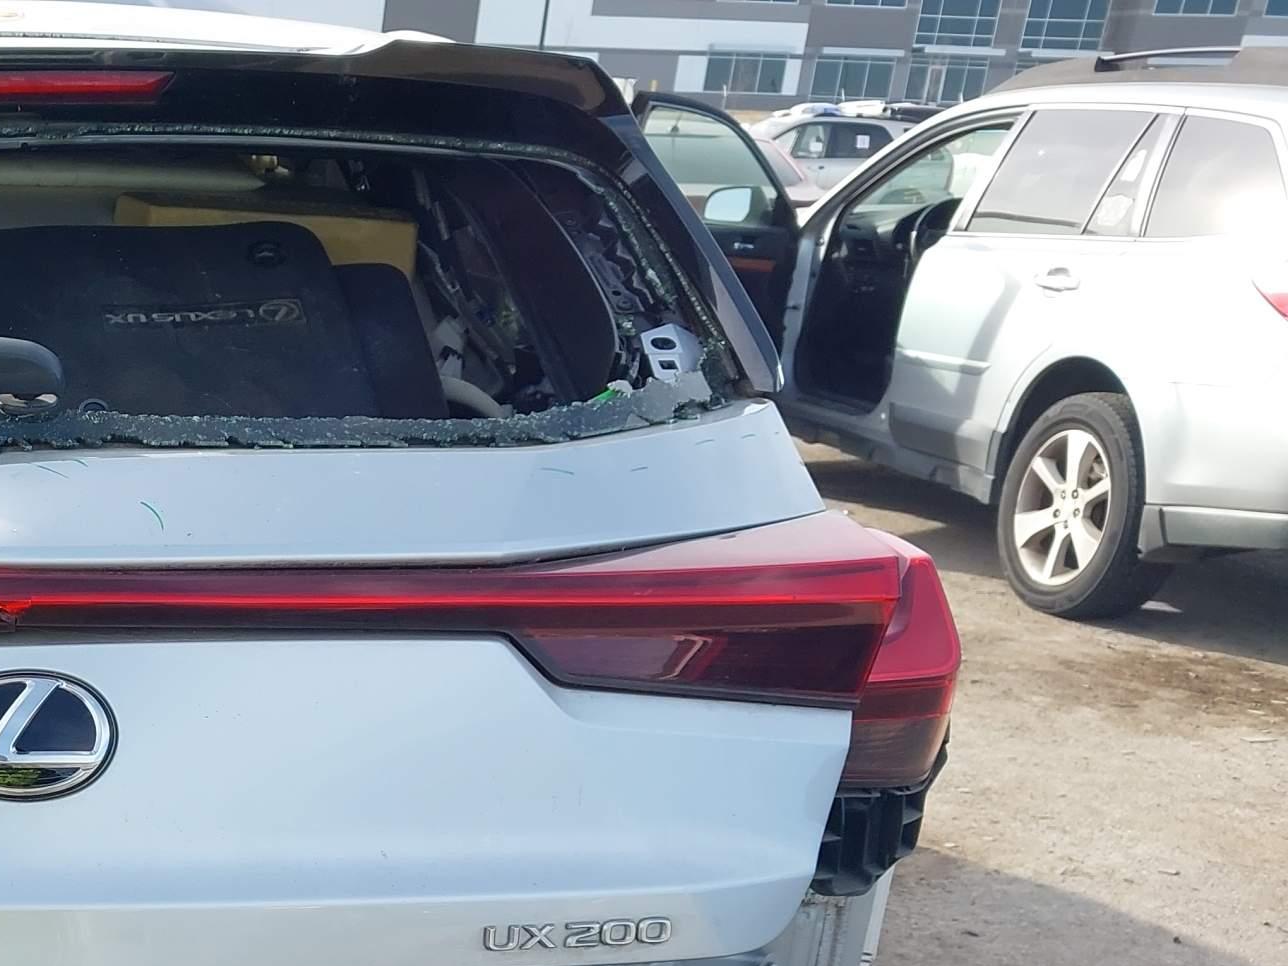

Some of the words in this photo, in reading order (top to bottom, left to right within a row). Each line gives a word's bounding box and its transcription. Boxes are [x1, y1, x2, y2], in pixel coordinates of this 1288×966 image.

[105, 312, 148, 324] UX
[152, 308, 255, 322] LEXUS
[483, 923, 557, 951] UX
[563, 916, 672, 948] 200
